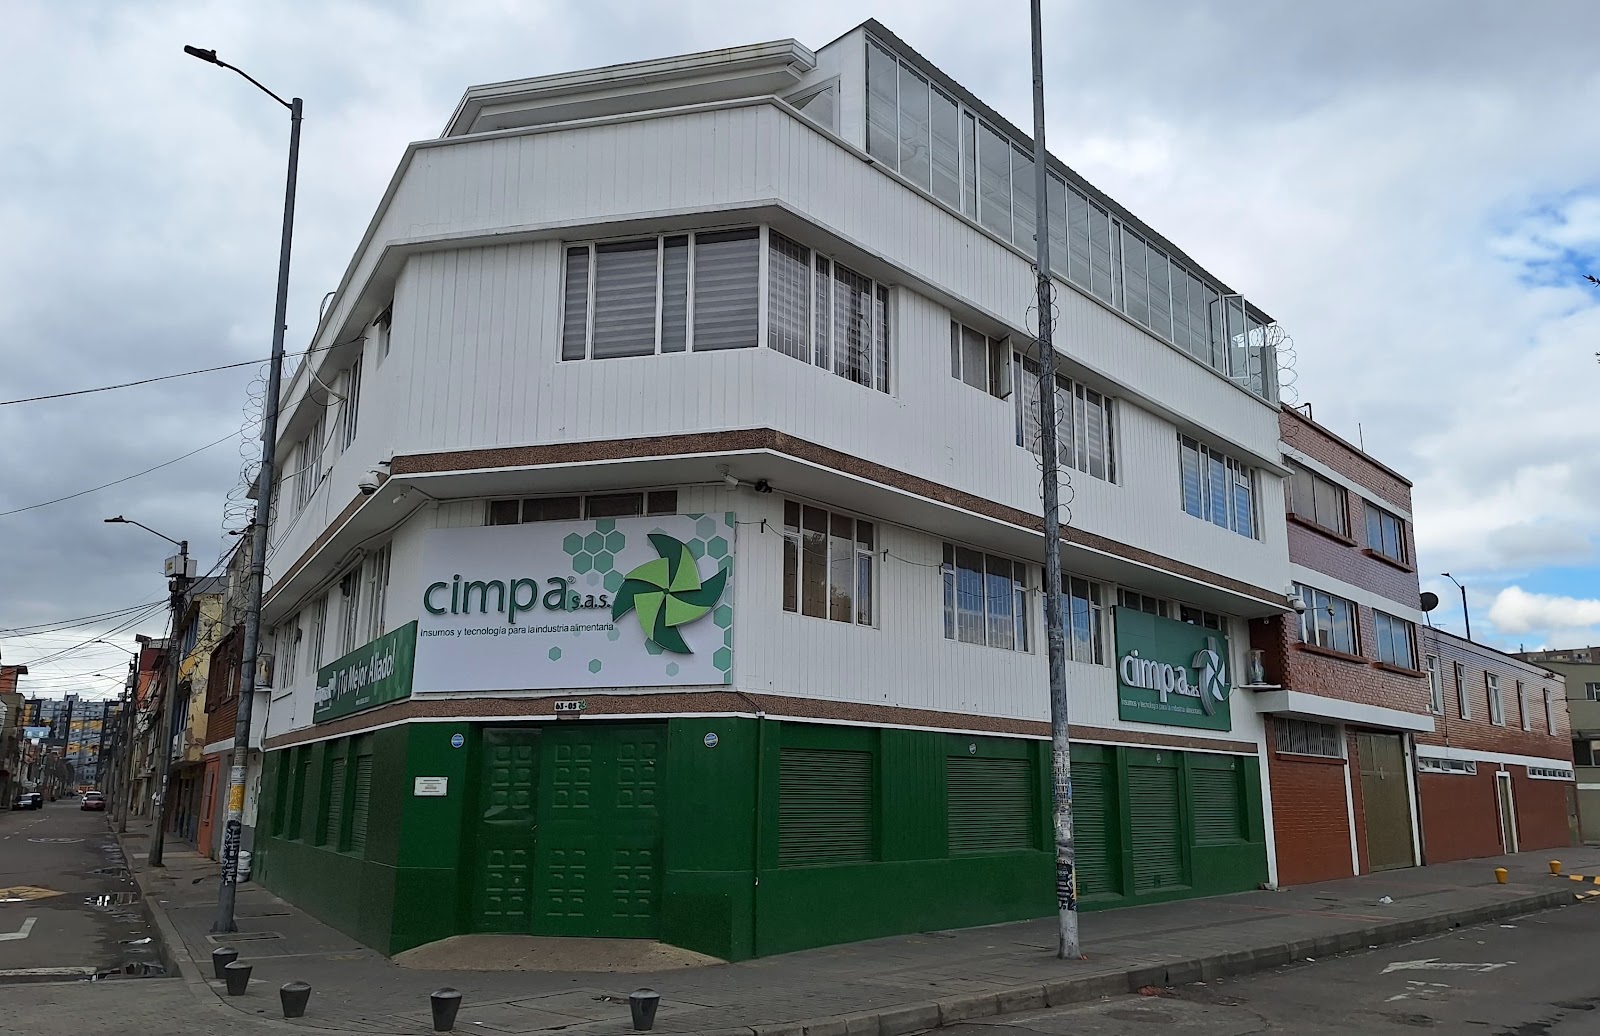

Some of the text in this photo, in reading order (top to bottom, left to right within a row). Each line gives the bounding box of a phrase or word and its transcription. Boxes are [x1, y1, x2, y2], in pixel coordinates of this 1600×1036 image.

[423, 574, 569, 624] cimpa
[420, 628, 455, 637] Insumos
[457, 629, 462, 638] y
[464, 626, 507, 637] tecnología
[508, 626, 526, 636] para
[535, 623, 569, 633] industria
[569, 622, 614, 632] alimentaria
[347, 660, 368, 697] Mejor
[1120, 649, 1188, 703] cimpa
